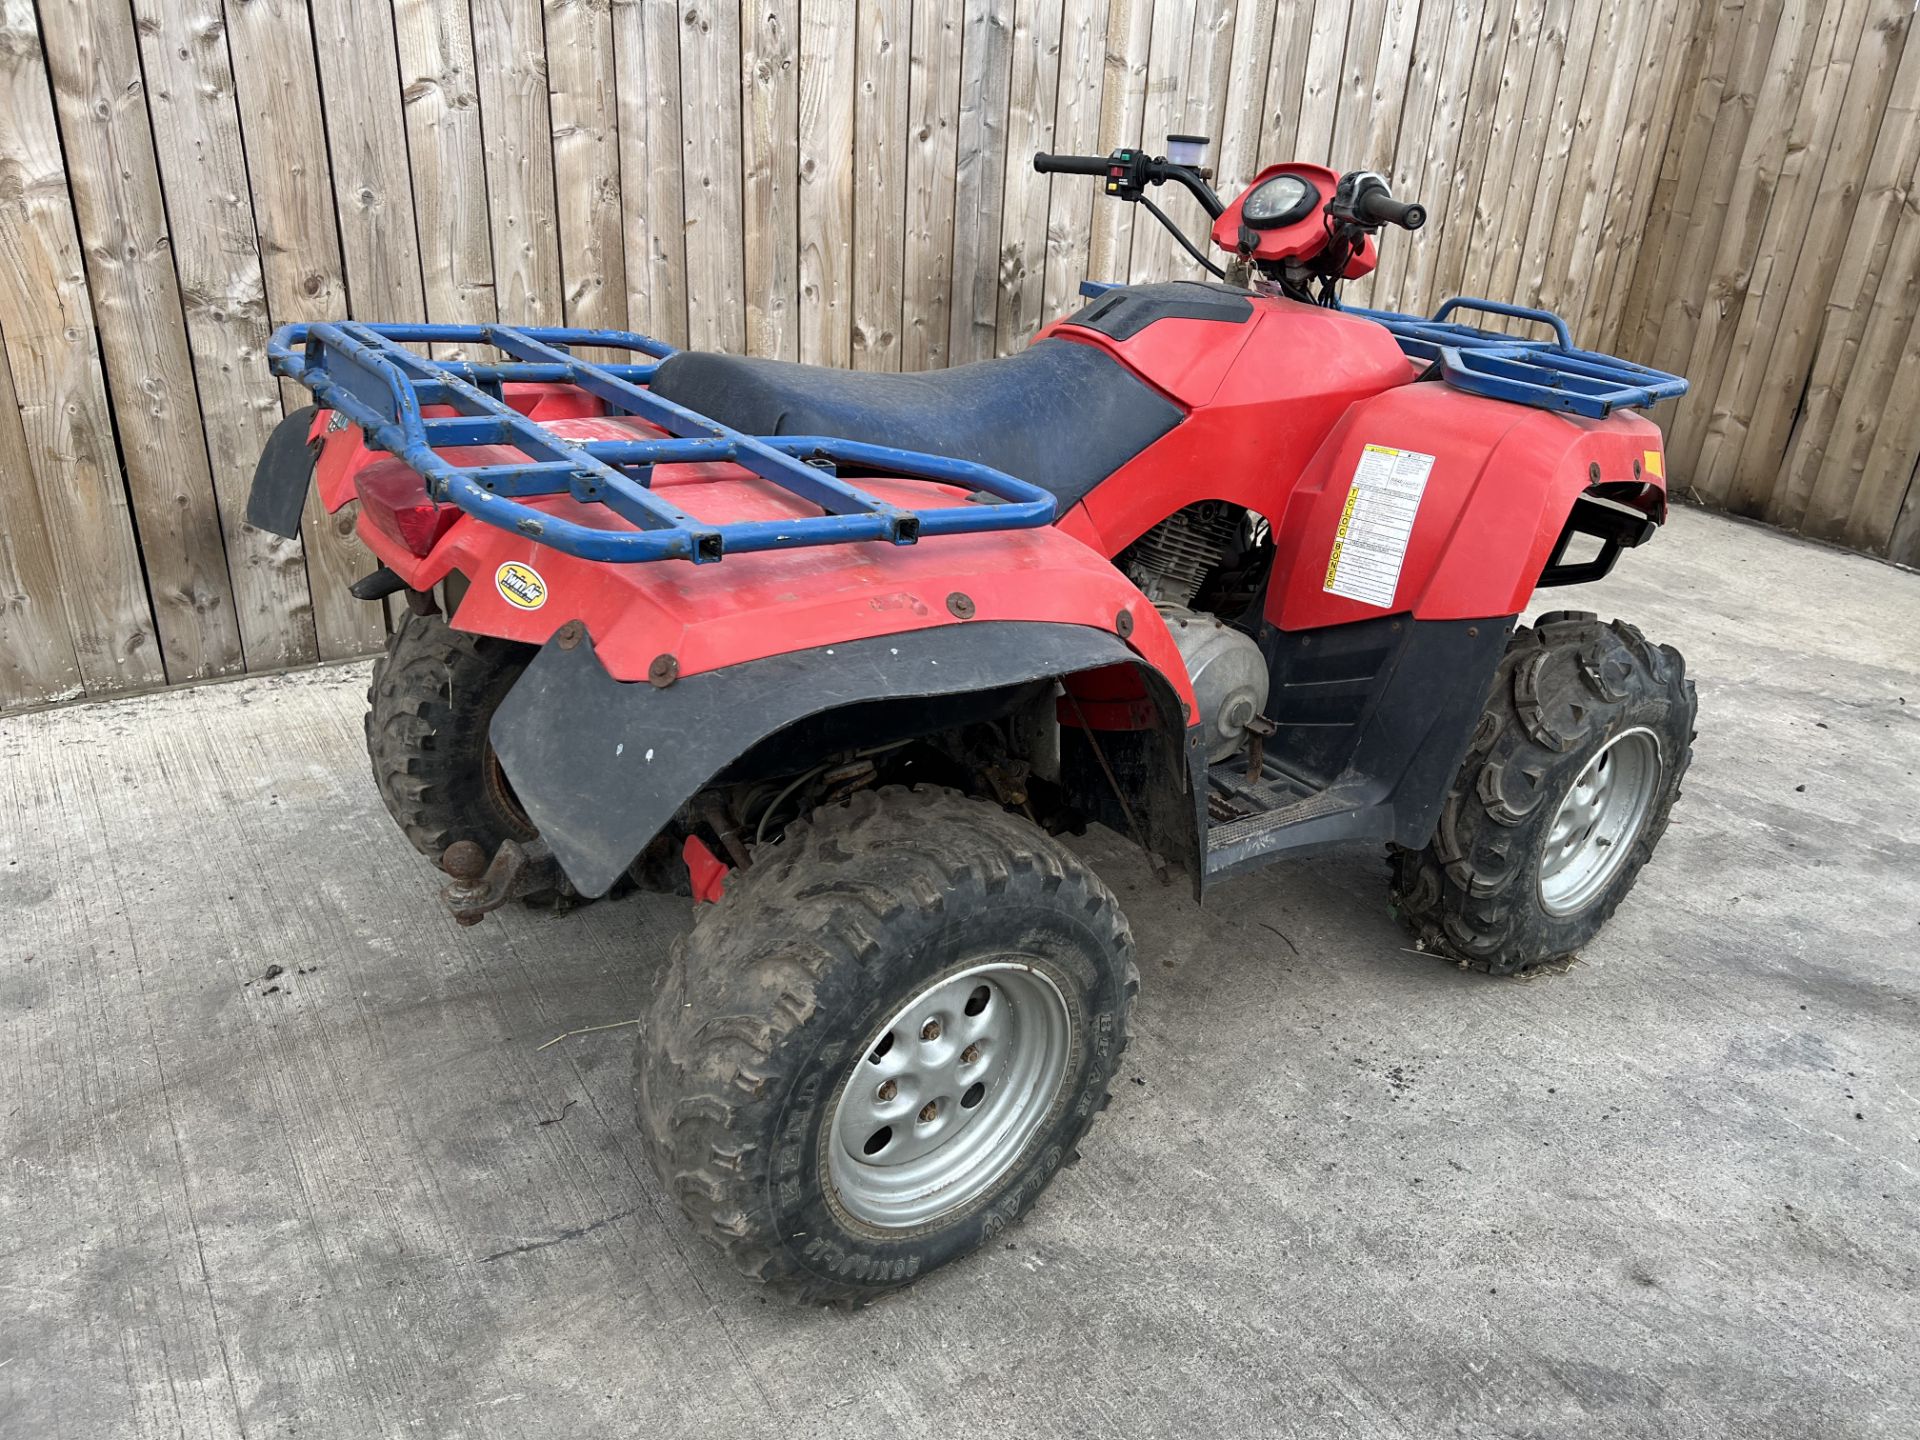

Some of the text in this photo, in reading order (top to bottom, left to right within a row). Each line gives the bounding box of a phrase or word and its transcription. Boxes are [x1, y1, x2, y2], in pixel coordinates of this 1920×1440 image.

[501, 567, 527, 592] Twin
[981, 1013, 1113, 1242] BEAR CLAW
